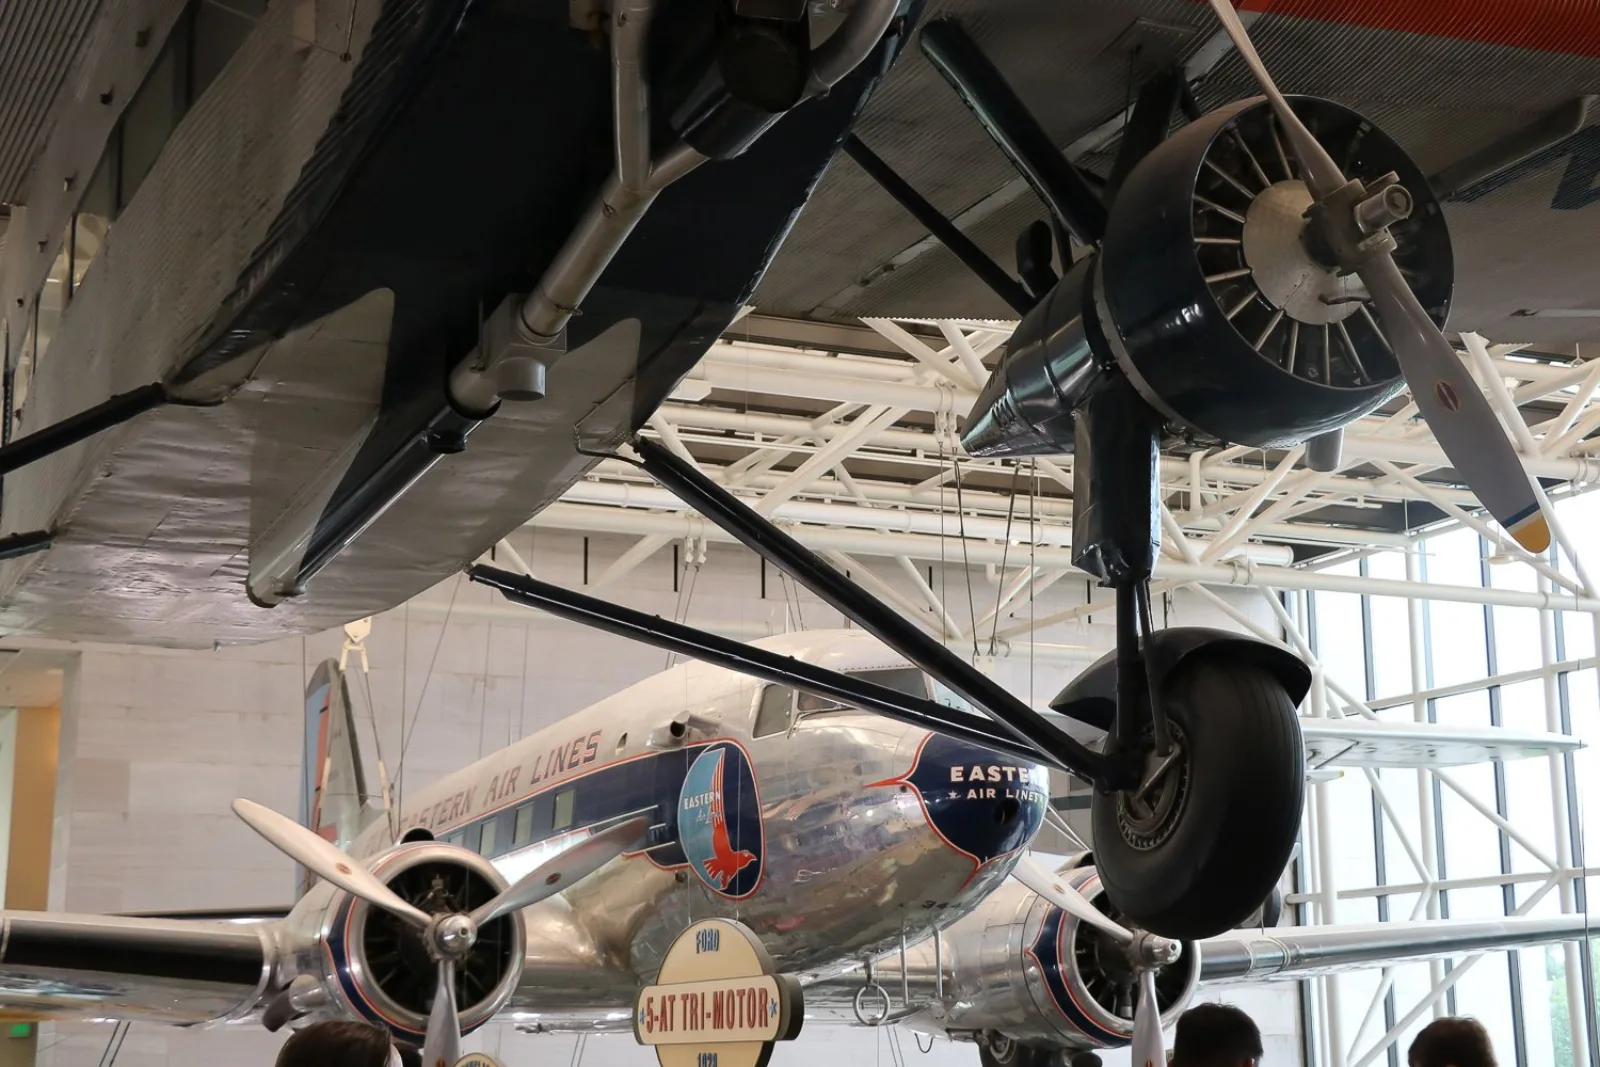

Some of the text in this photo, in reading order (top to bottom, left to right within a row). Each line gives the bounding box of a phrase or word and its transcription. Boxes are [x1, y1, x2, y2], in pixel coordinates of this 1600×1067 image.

[483, 766, 522, 806] AIR
[530, 730, 602, 785] LINES
[951, 766, 1029, 783] EASTE
[684, 789, 720, 810] EASTERN
[967, 788, 1039, 802] AIR LINES
[696, 928, 720, 954] FORD
[645, 987, 769, 1034] 5-AT TRI-MOTOR
